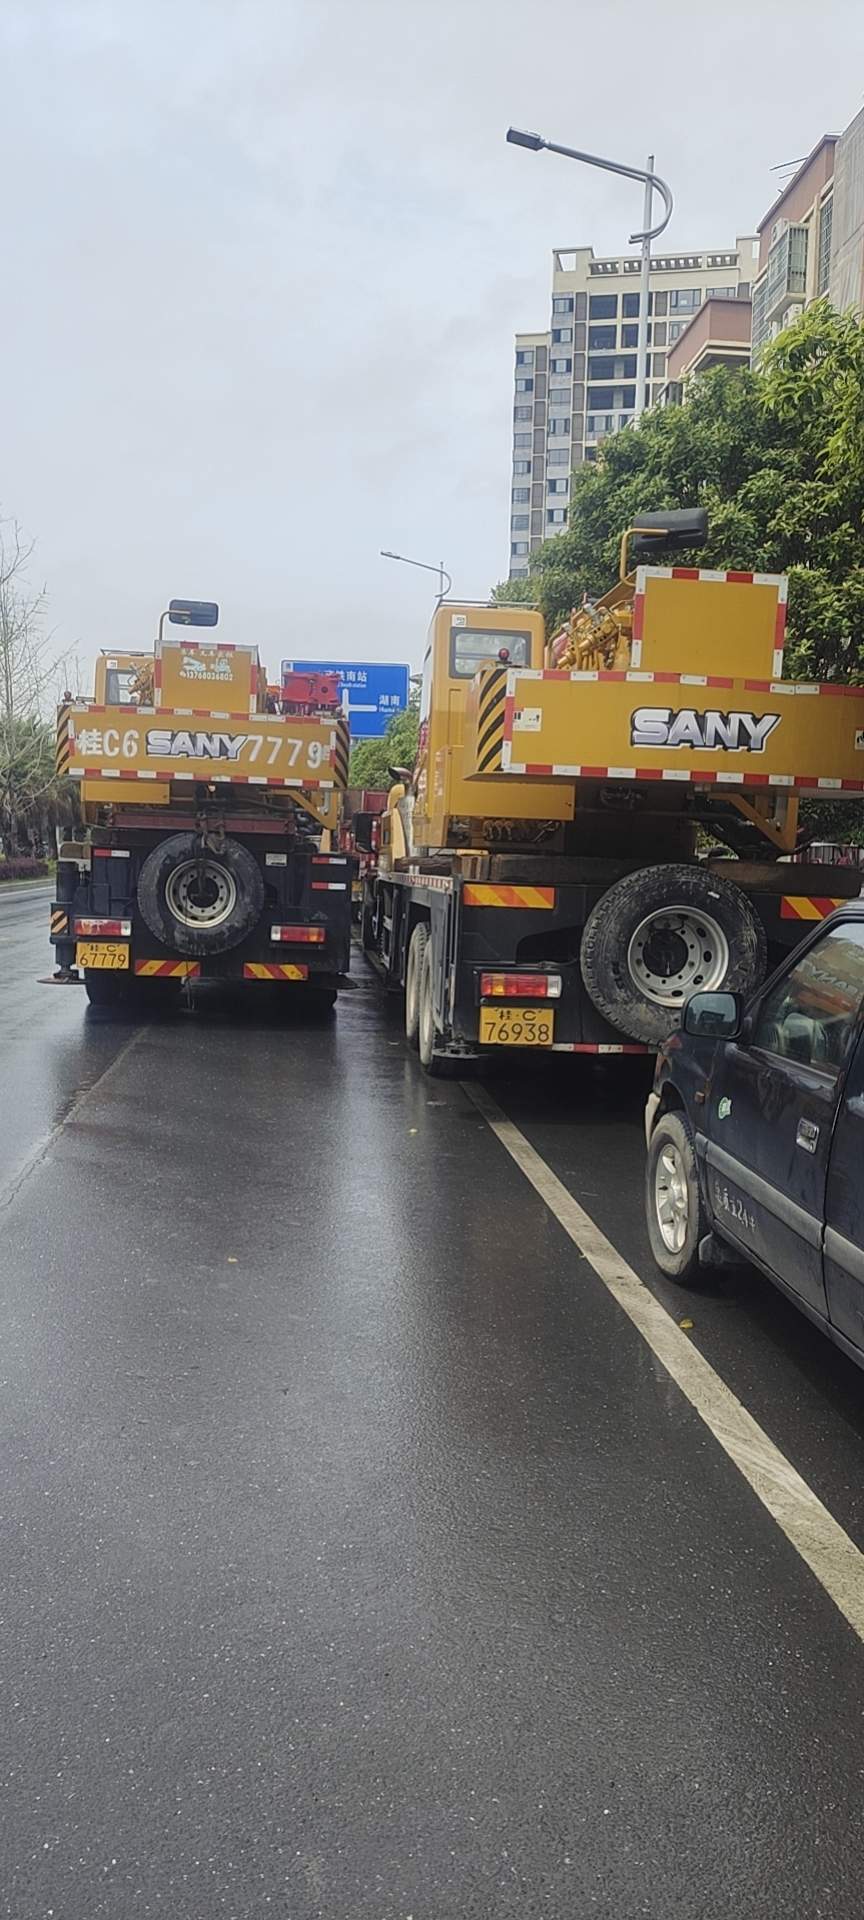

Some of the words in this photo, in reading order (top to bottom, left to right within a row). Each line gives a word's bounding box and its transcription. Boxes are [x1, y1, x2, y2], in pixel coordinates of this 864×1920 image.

[631, 707, 781, 754] SANY
[76, 728, 140, 759] 桂C6
[146, 730, 249, 762] SANY
[249, 734, 322, 769] 7779
[80, 952, 127, 967] 67779
[484, 1022, 549, 1042] 76938
